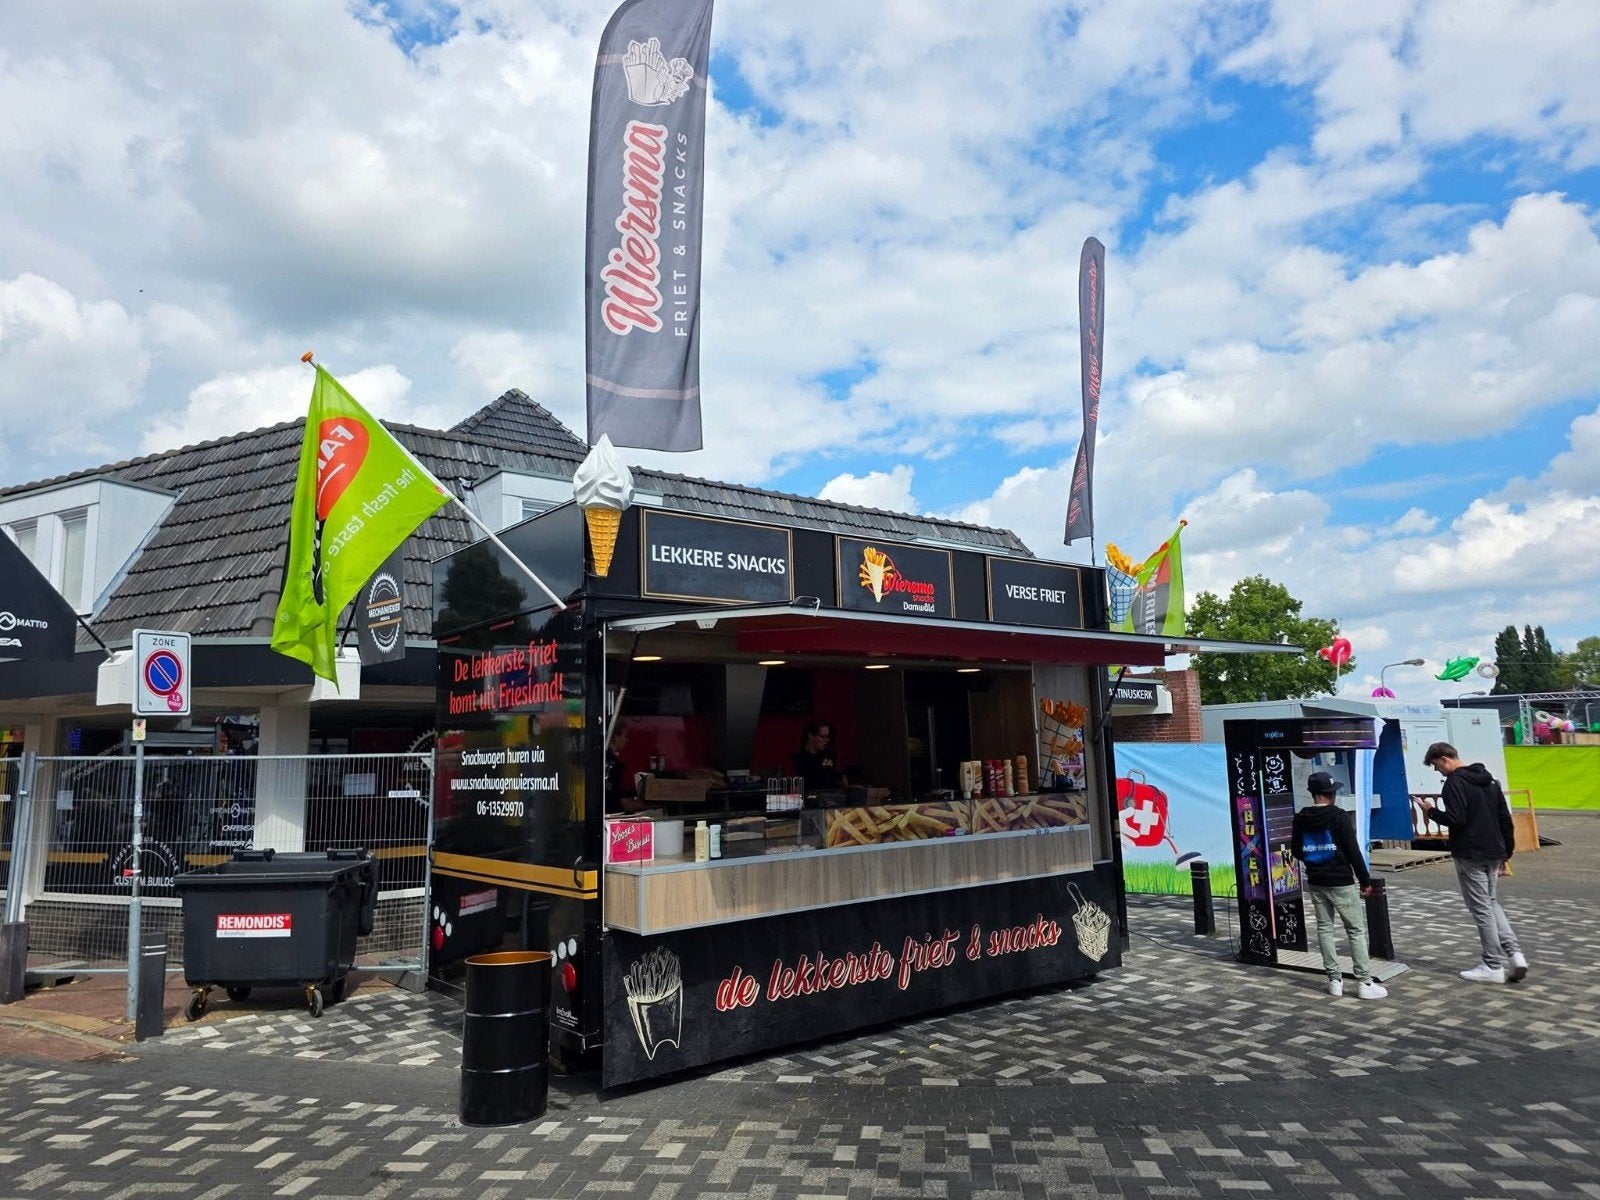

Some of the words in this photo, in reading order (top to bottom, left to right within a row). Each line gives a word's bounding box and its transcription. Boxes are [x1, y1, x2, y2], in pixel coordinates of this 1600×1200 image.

[674, 132, 688, 231] SNACKS
[603, 121, 666, 334] Wiersma
[673, 244, 687, 257] &
[674, 271, 688, 338] FRIET
[651, 544, 723, 568] LEKKERE
[728, 553, 786, 575] SNACKS
[1006, 584, 1038, 601] VERSE
[1040, 589, 1066, 604] FRIET
[152, 638, 176, 647] ZONE
[455, 659, 469, 682] De
[472, 647, 525, 679] lekkerste
[527, 639, 558, 675] friet
[449, 690, 477, 715] komt
[480, 684, 496, 711] uit
[499, 672, 564, 708] Friesland!
[461, 749, 506, 769] Snackwagen
[507, 747, 530, 764] huren
[531, 745, 545, 763] via
[450, 772, 559, 795] www.snackwagenwiersma.nl
[476, 801, 524, 818] 06-13529970
[114, 875, 146, 887] CUSTM
[147, 876, 175, 887] BUILDS
[218, 915, 285, 929] REMONDIS
[715, 965, 760, 1012] de
[767, 941, 895, 1002] lekkerste
[898, 928, 960, 990] friet
[966, 923, 981, 961] &
[987, 913, 1062, 956] snacks
